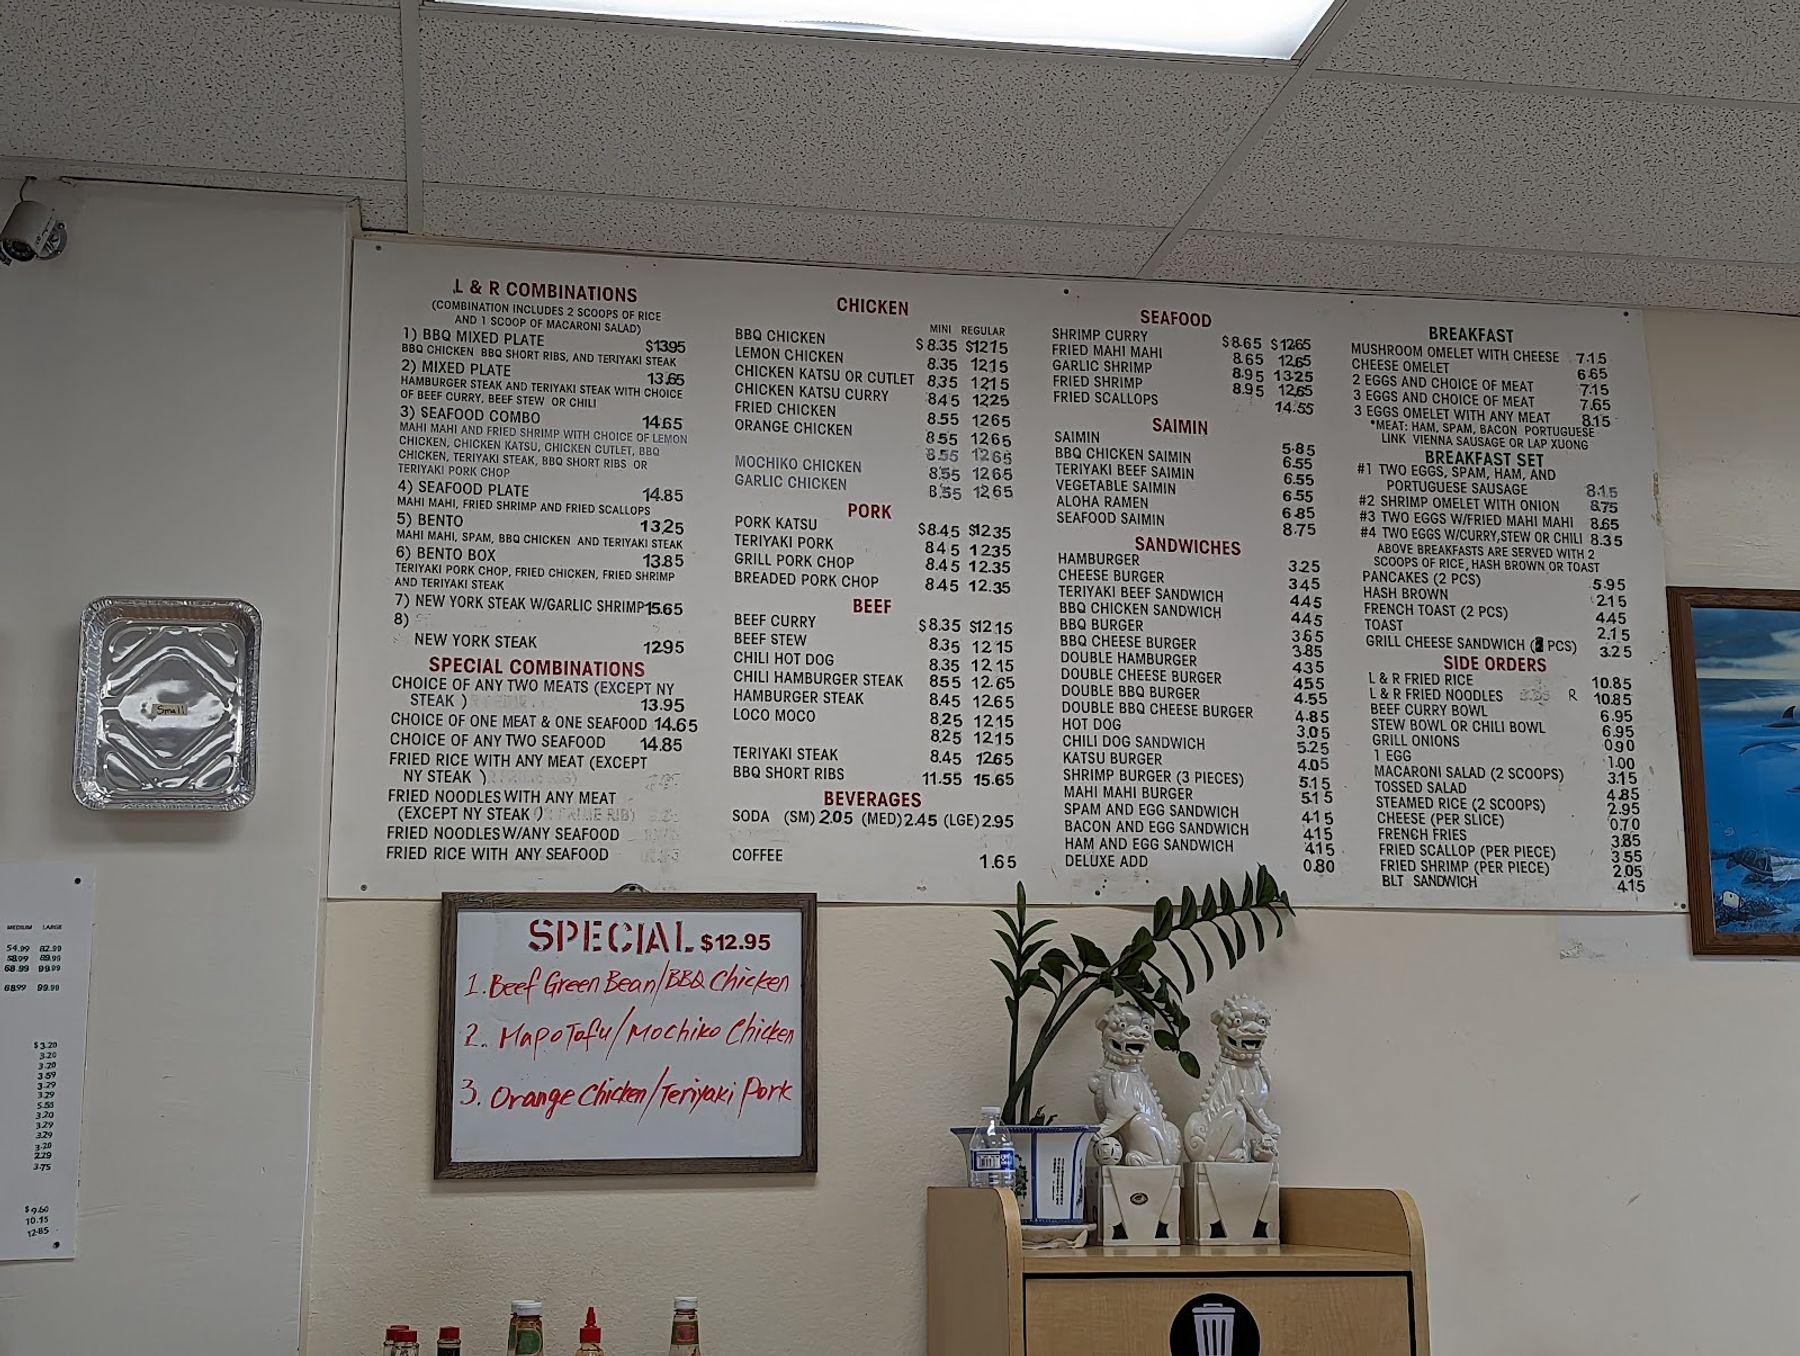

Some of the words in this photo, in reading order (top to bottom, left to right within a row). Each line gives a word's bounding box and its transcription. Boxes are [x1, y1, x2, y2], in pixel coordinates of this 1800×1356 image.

[470, 280, 482, 294] &
[490, 280, 499, 295] R
[506, 282, 637, 302] COMBINATIONS
[432, 300, 509, 312] (COMBINATION
[513, 304, 563, 316] INCLUDES
[567, 307, 573, 317] 2
[578, 308, 618, 319] SCOOPS
[622, 310, 634, 319] OF
[638, 311, 661, 321] RICE
[837, 297, 908, 316] CHICKEN
[1141, 310, 1212, 327] SEAFOOD
[736, 328, 761, 341] BBQ
[767, 330, 825, 344] CHICKEN
[930, 324, 951, 333] MINI
[961, 326, 1005, 336] REGULAR
[1052, 328, 1100, 340] SHRIMP
[1105, 330, 1148, 342] CURRY
[1429, 326, 1513, 343] BREAKFAST
[736, 346, 779, 360] LEMON
[785, 349, 843, 363] CHICKEN
[1352, 343, 1422, 357] MUSHROOM
[1427, 347, 1474, 359] OMELET
[1477, 348, 1509, 361] WITH
[1513, 350, 1559, 362] CHEESE
[1053, 359, 1099, 371] GARLIC
[1104, 360, 1152, 373] SHRIMP
[1352, 358, 1398, 371] CHEESE
[1403, 361, 1450, 373] OMELET
[1275, 401, 1314, 415] 14.55
[735, 419, 788, 433] ORANGE
[794, 422, 852, 436] CHICKEN
[1153, 418, 1207, 436] SAIMIN
[1055, 431, 1099, 443] SAIMIN
[1425, 450, 1511, 466] BREAKFAST
[1517, 453, 1544, 468] SET
[398, 480, 413, 495] 4)
[419, 481, 482, 495] SEAFOOD
[489, 484, 528, 497] PLATE
[735, 474, 783, 487] GARLIC
[788, 476, 846, 490] CHICKEN
[643, 488, 683, 502] 14.85
[1057, 495, 1099, 507] ALOHA
[1105, 496, 1148, 509] RAMEN
[848, 503, 891, 519] PORK
[734, 534, 792, 548] TERIYAKI
[798, 537, 833, 550] PORK
[1135, 536, 1241, 555] SANDWICHES
[396, 546, 411, 561] 6)
[418, 547, 462, 560] BENTO
[468, 549, 496, 562] BOX
[643, 554, 684, 568] 13.85
[1058, 552, 1139, 566] HAMBURGER
[1363, 571, 1428, 584] PANCAKES
[1434, 573, 1446, 587] (2
[1452, 573, 1481, 588] PCS)
[853, 599, 891, 614] BEEF
[735, 613, 766, 626] BEEF
[771, 615, 816, 628] CURRY
[1060, 618, 1086, 630] BBQ
[1092, 618, 1143, 631] BURGER
[1365, 619, 1403, 631] TOAST
[415, 633, 447, 646] NEW
[453, 634, 490, 647] YORK
[495, 635, 537, 648] STEAK
[734, 651, 768, 664] CHILI
[775, 652, 801, 665] HOT
[806, 653, 834, 666] DOG
[1444, 655, 1479, 670] SIDE
[1485, 656, 1546, 672] ORDERS
[429, 656, 503, 674] SPECIAL
[510, 659, 644, 677] COMBINATIONS
[1592, 677, 1631, 690] 10.85
[157, 705, 184, 715] Small
[641, 698, 685, 712] 13.95
[1371, 703, 1400, 715] BEEF
[1405, 704, 1447, 716] CURRY
[1452, 705, 1488, 717] BOWL
[391, 712, 443, 726] CHOICE
[449, 714, 465, 727] OF
[470, 715, 497, 727] ONE
[503, 715, 536, 728] MEAT
[541, 715, 550, 728] &
[555, 716, 582, 729] ONE
[587, 716, 647, 730] SEAFOOD
[734, 708, 769, 721] LOCO
[776, 709, 815, 722] MOCO
[1600, 710, 1632, 722] 6.95
[654, 717, 698, 732] 14.65
[1372, 734, 1407, 746] GRILL
[1412, 735, 1459, 747] ONIONS
[734, 766, 760, 778] BBQ
[766, 766, 810, 779] SHORT
[815, 768, 844, 780] RIBS
[922, 772, 962, 785] 11.55
[974, 772, 1014, 786] 15.65
[1064, 769, 1114, 781] SHRIMP
[1120, 769, 1171, 783] BURGER
[1177, 771, 1189, 785] (3
[1195, 771, 1244, 788] PIECES)
[1375, 765, 1441, 778] MACARONI
[1446, 766, 1485, 778] SALAD
[1491, 767, 1504, 782] (2
[1508, 768, 1564, 783] SCOOPS)
[824, 791, 921, 807] BEVERAGES
[1607, 802, 1640, 815] 2.95
[733, 809, 769, 822] SODA
[784, 811, 815, 826] (SM)
[862, 812, 902, 828] (MED)
[904, 813, 937, 827] 2.45
[944, 814, 979, 829] (LGE)
[982, 815, 1014, 828] 2.95
[1065, 820, 1110, 832] BACON
[1116, 820, 1144, 832] AND
[1149, 821, 1174, 833] EGG
[1180, 822, 1249, 836] SANDWICH
[1378, 827, 1428, 840] FRENCH
[1433, 828, 1467, 841] FRIES
[387, 846, 427, 859] FRIED
[434, 847, 466, 860] RICE
[471, 847, 508, 860] WITH
[515, 848, 542, 860] ANY
[546, 848, 608, 861] SEAFOOD
[733, 849, 783, 861] COFFEE
[1066, 854, 1115, 867] DELUXE
[1120, 855, 1148, 867] ADD
[980, 854, 1016, 869] 1.65
[1382, 875, 1404, 887] BLT
[1414, 875, 1477, 888] SANDWICH
[528, 919, 694, 954] SPECIAL
[700, 934, 771, 953] $12.95
[544, 970, 600, 994] Green
[709, 963, 789, 992] Chicken
[725, 1011, 795, 1045] Chicken
[460, 1079, 481, 1106] 3.
[490, 1084, 575, 1120] Orange
[737, 1076, 793, 1119] Pork
